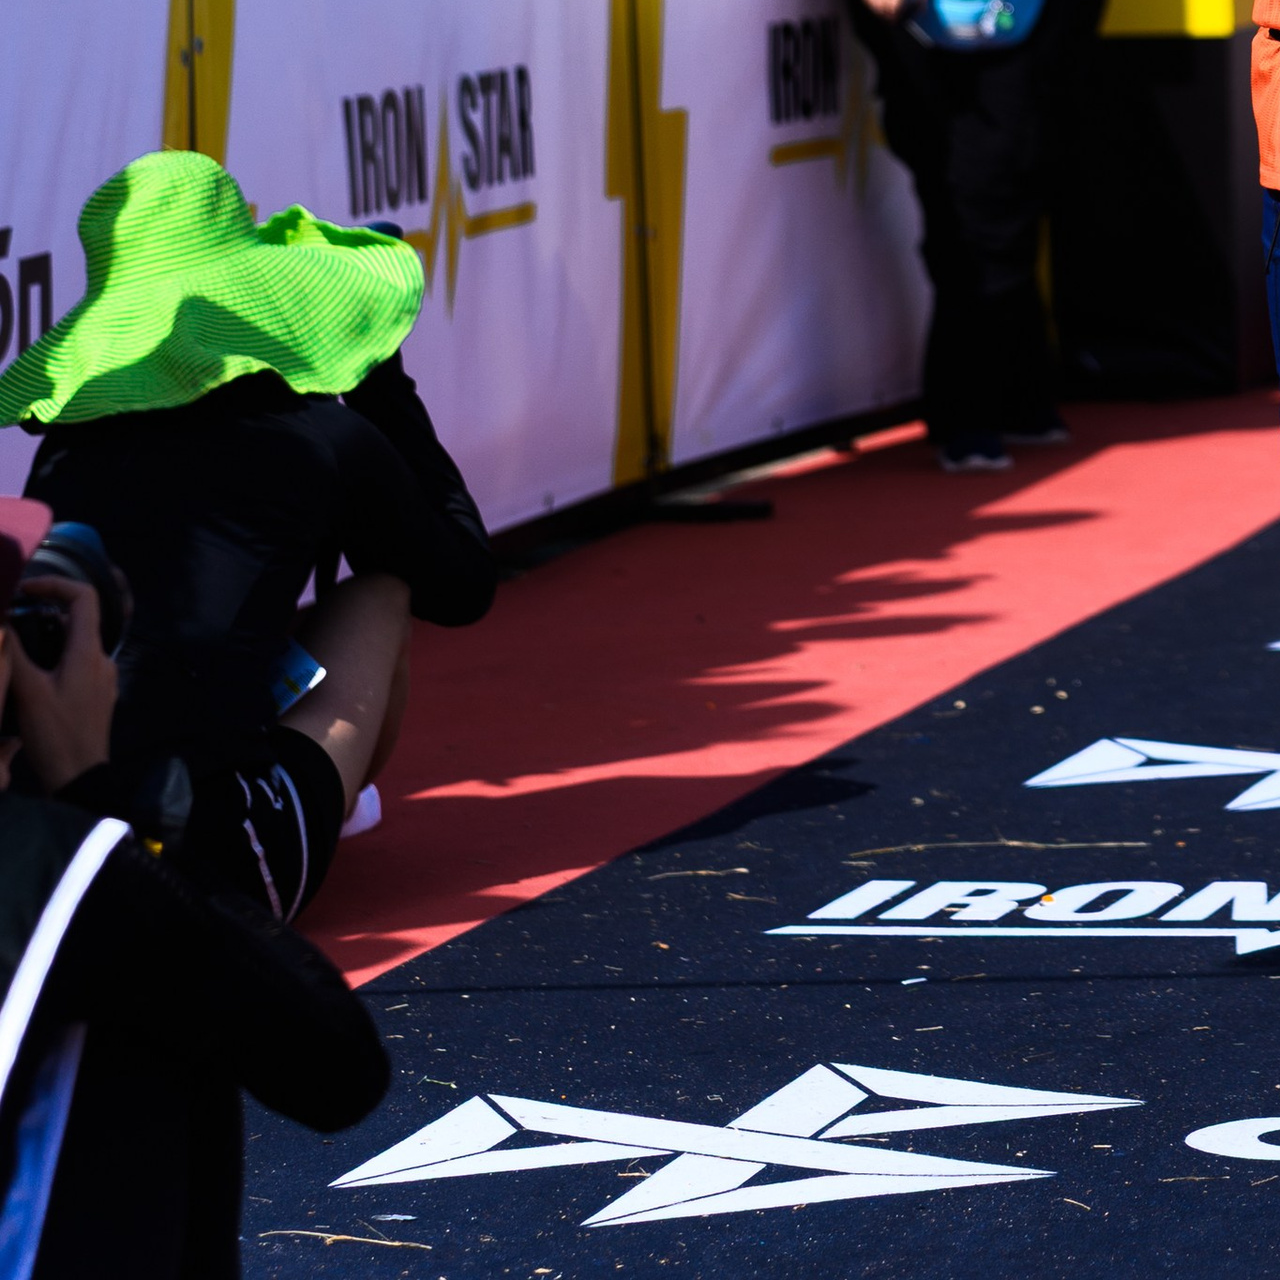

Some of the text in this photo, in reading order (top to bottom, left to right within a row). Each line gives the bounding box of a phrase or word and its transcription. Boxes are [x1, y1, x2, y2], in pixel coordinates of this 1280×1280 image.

[768, 17, 839, 125] IRON
[343, 65, 534, 218] IRON STAR
